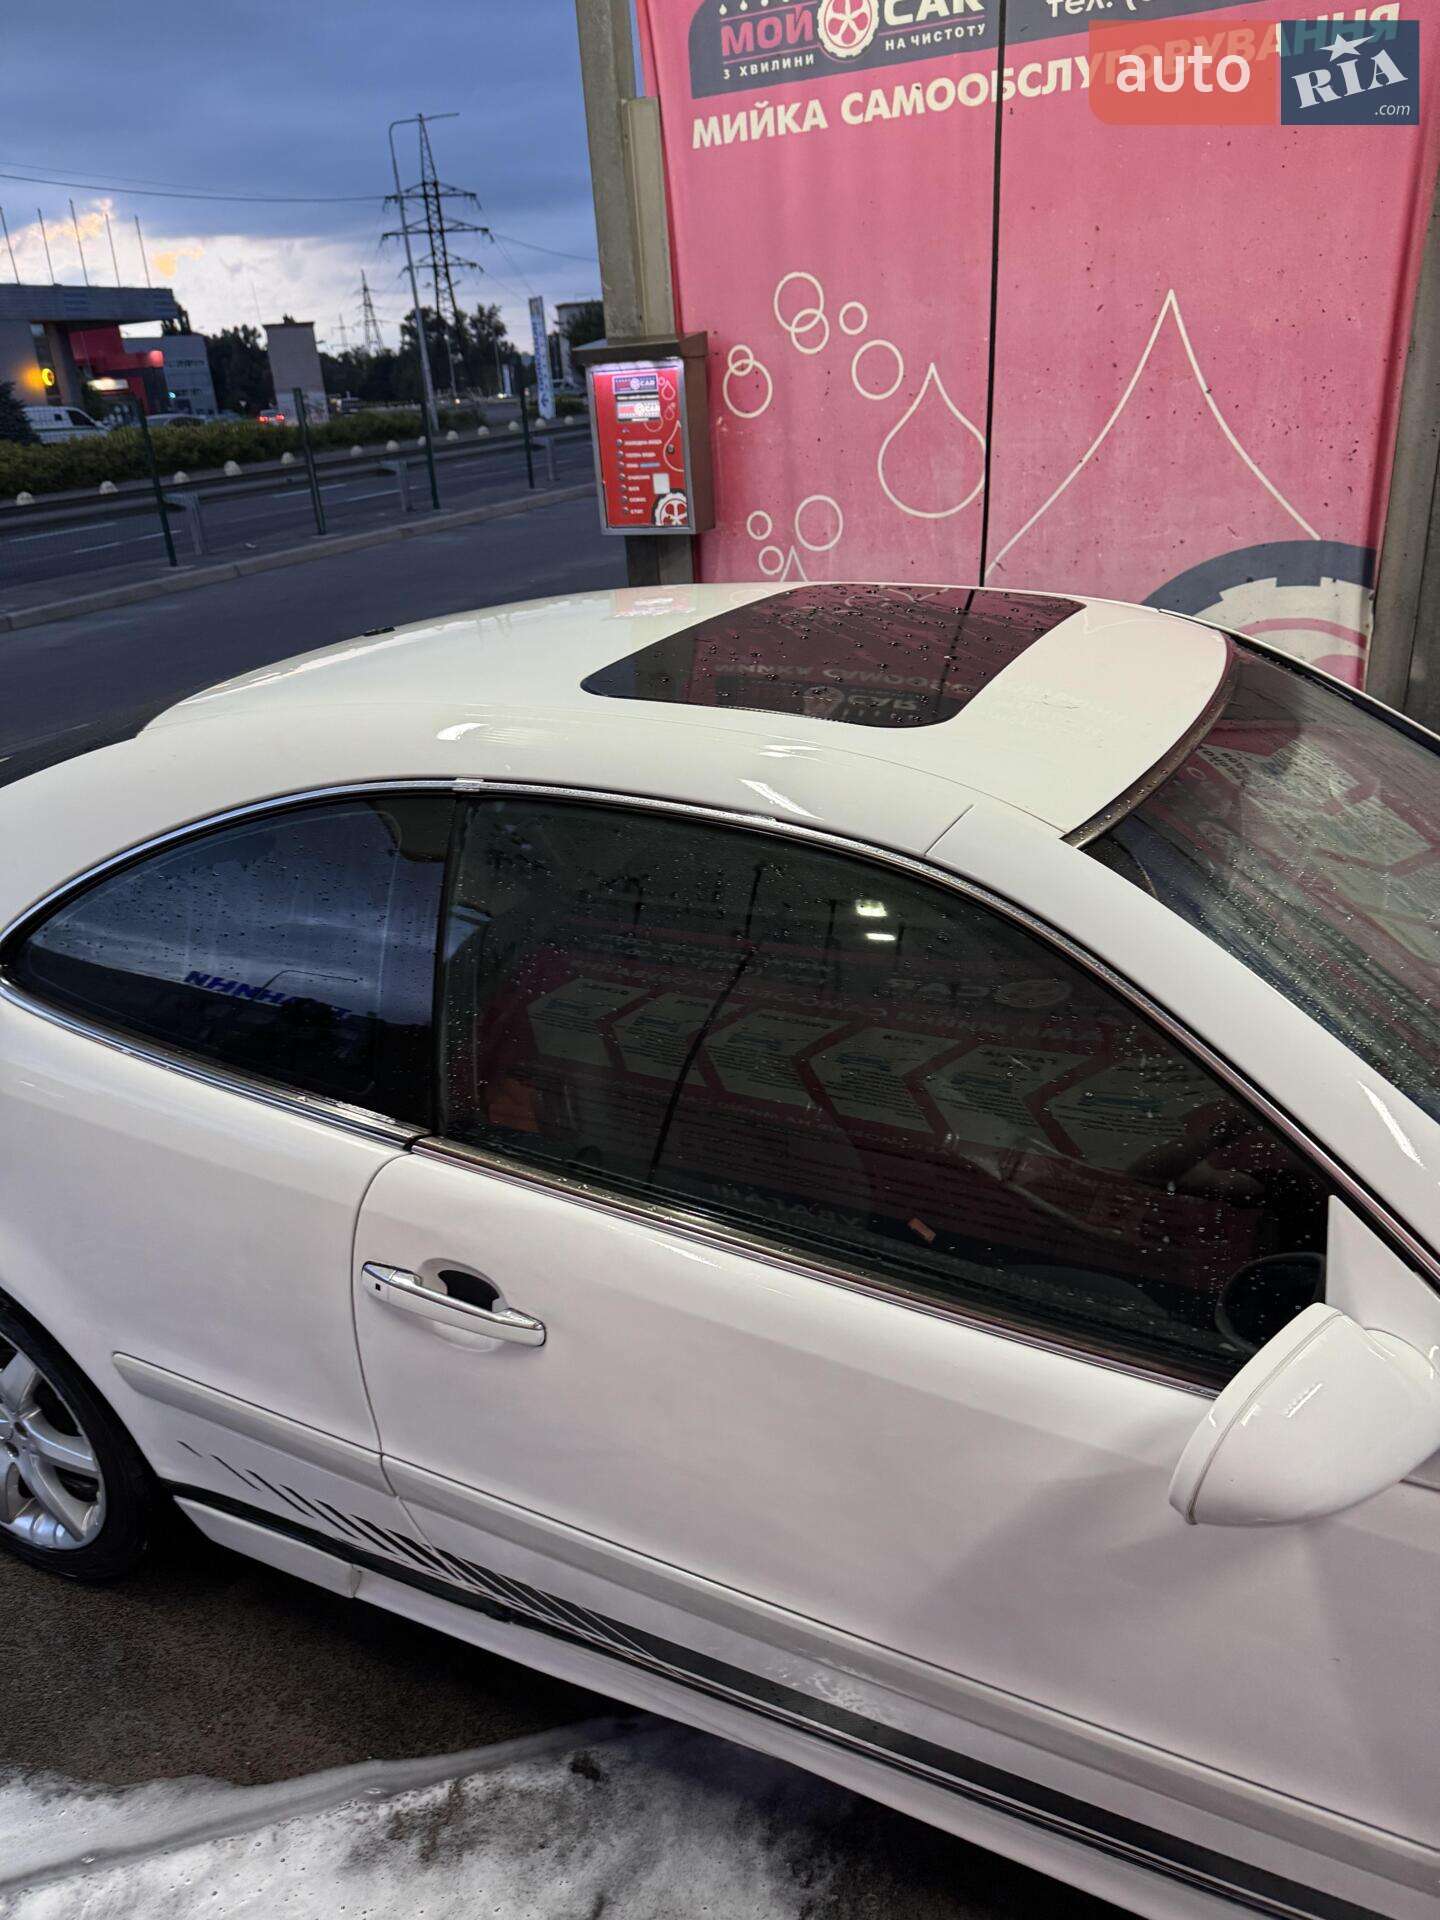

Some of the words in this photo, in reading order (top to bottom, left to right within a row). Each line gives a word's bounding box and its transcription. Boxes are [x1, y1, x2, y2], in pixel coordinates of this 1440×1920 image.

[885, 37, 907, 51] НА
[910, 23, 986, 46] ЧИСТОТУ
[739, 54, 815, 77] ХВИЛИНИ
[692, 99, 829, 150] МИЙКА
